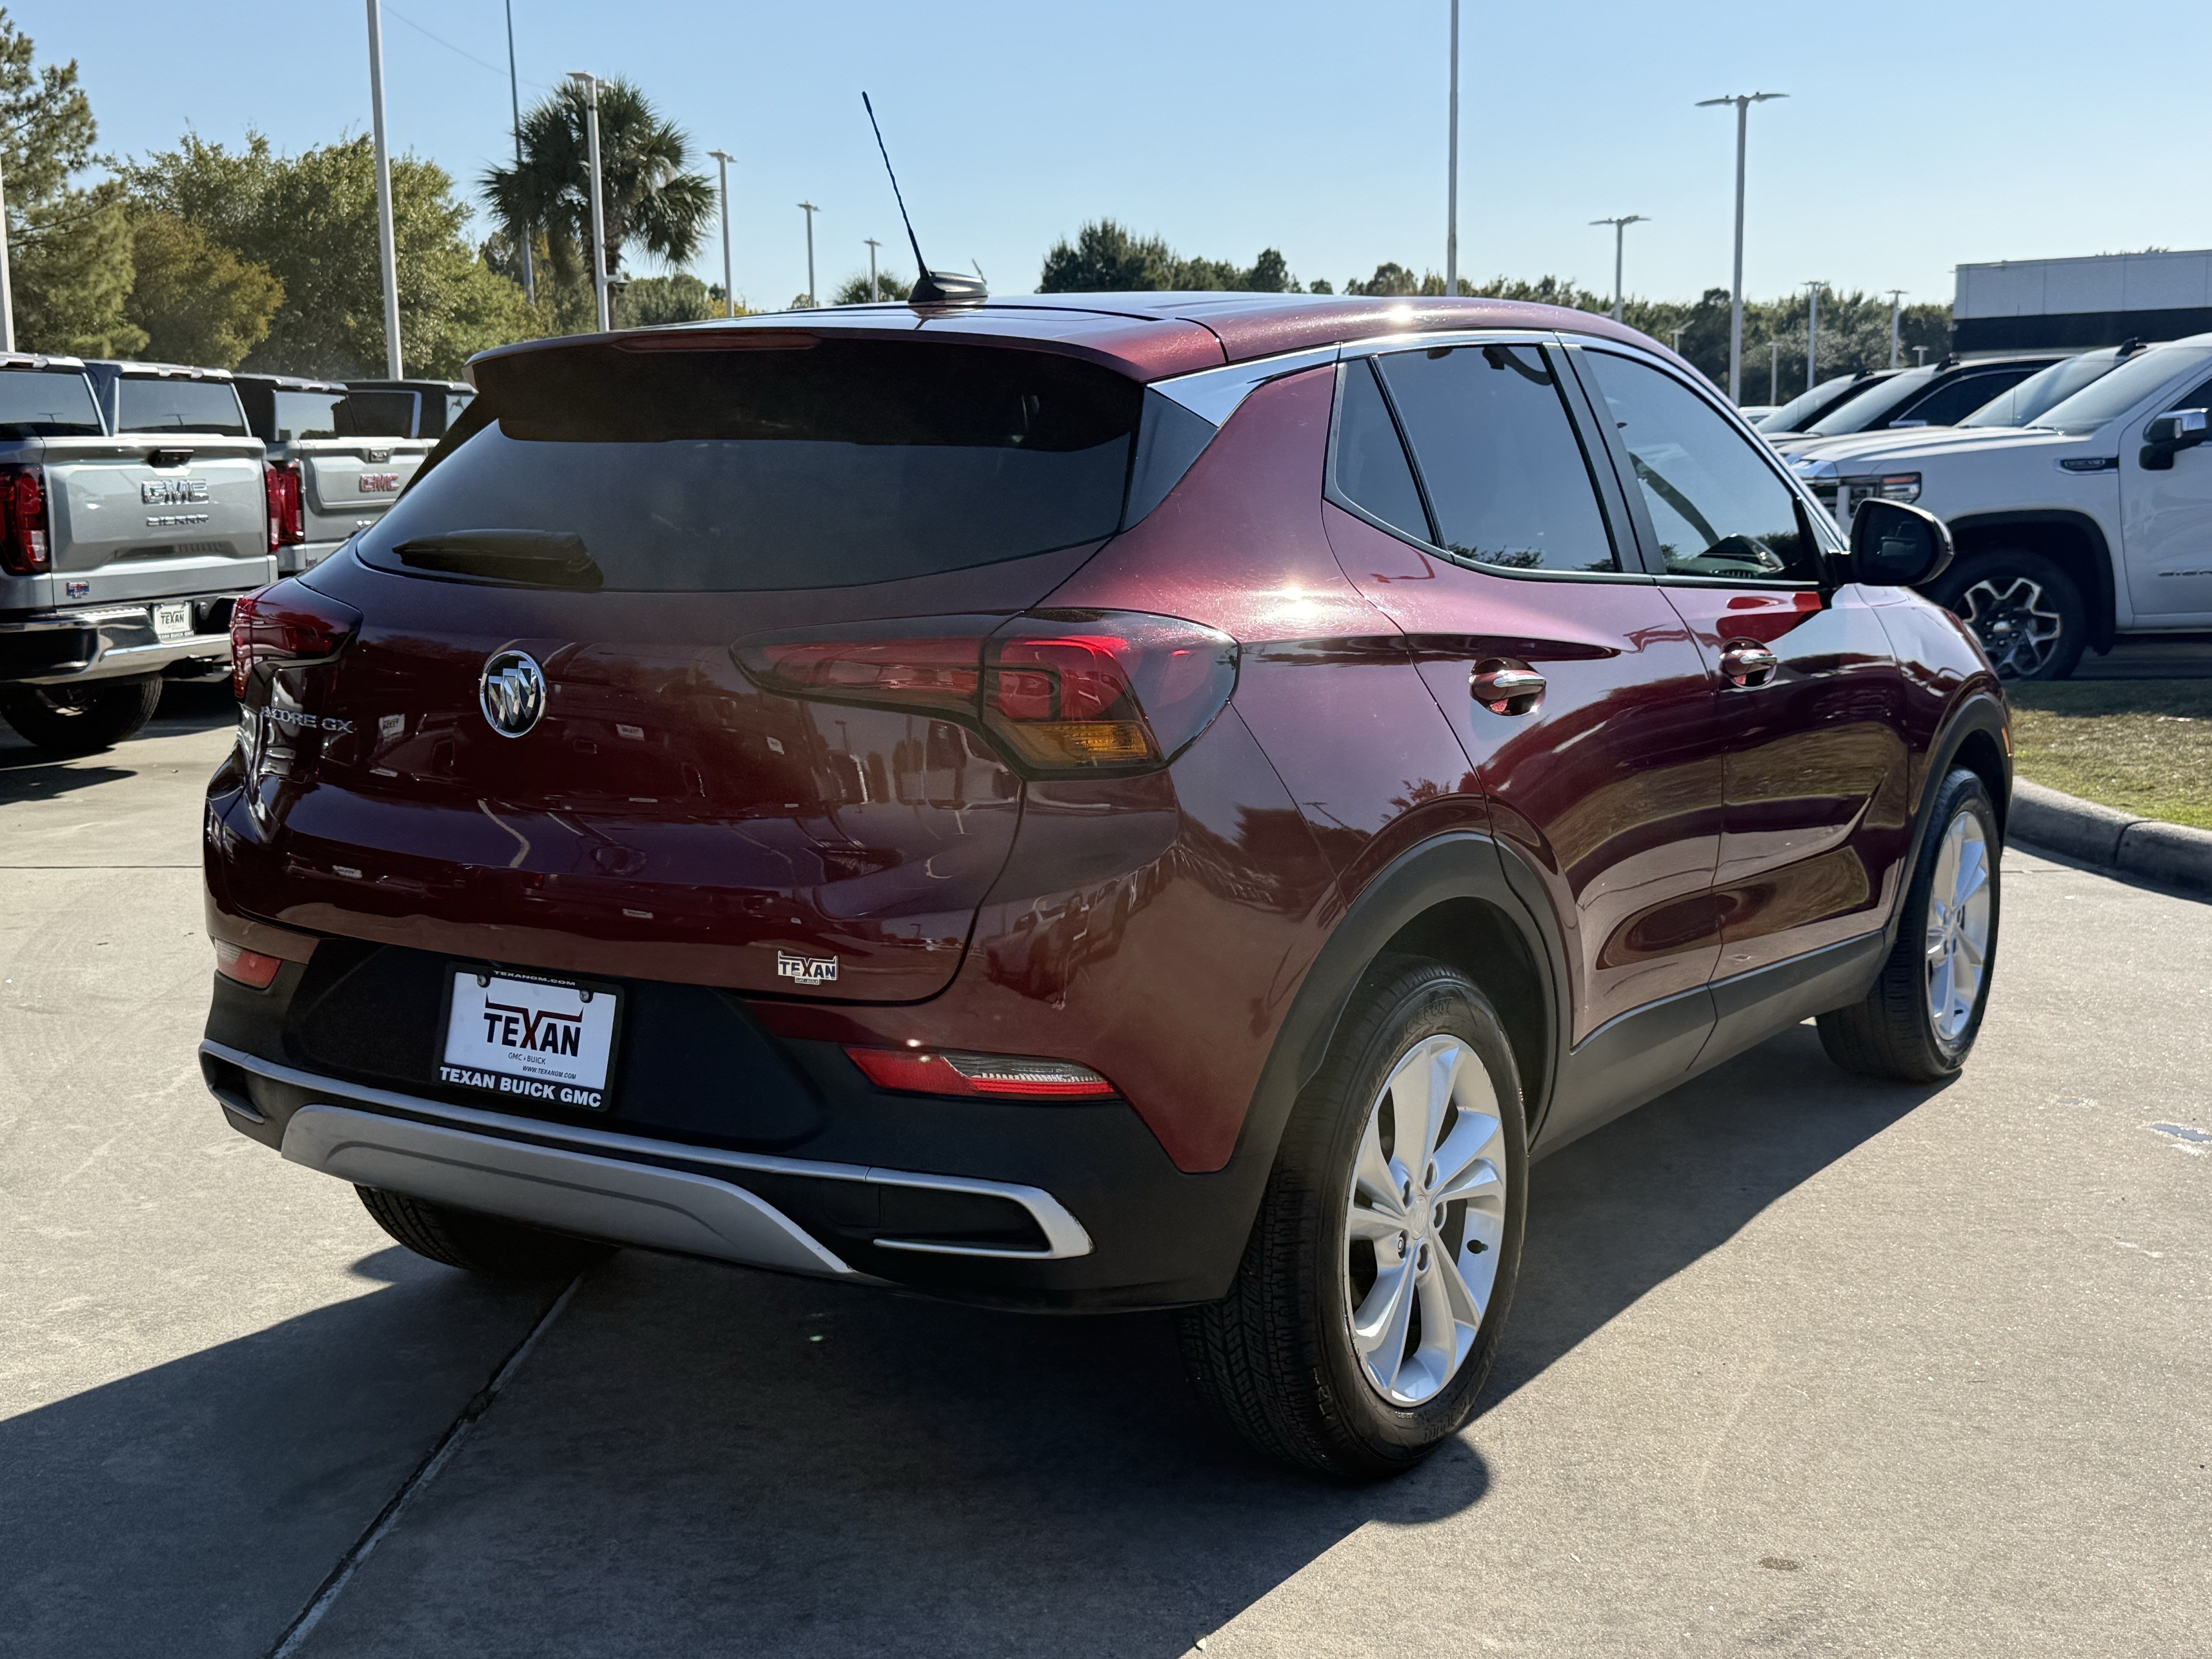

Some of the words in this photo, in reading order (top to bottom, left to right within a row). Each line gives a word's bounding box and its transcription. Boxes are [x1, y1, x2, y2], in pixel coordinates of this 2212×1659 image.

[359, 474, 400, 493] GMC
[141, 479, 209, 505] GMC
[147, 514, 209, 527] SIERRA
[161, 611, 184, 625] TEXAN
[321, 718, 354, 733] GX
[778, 957, 836, 979] TEXAN
[494, 970, 575, 986] TEXANGM.COM
[483, 1001, 583, 1057] TEXAN
[508, 1052, 522, 1061] GMC
[527, 1054, 546, 1065] BUICK
[523, 1065, 577, 1079] WWW.TEXANGM.COM
[440, 1066, 496, 1089] TEXAN
[500, 1077, 555, 1100] BUICK
[560, 1090, 601, 1108] GMC
